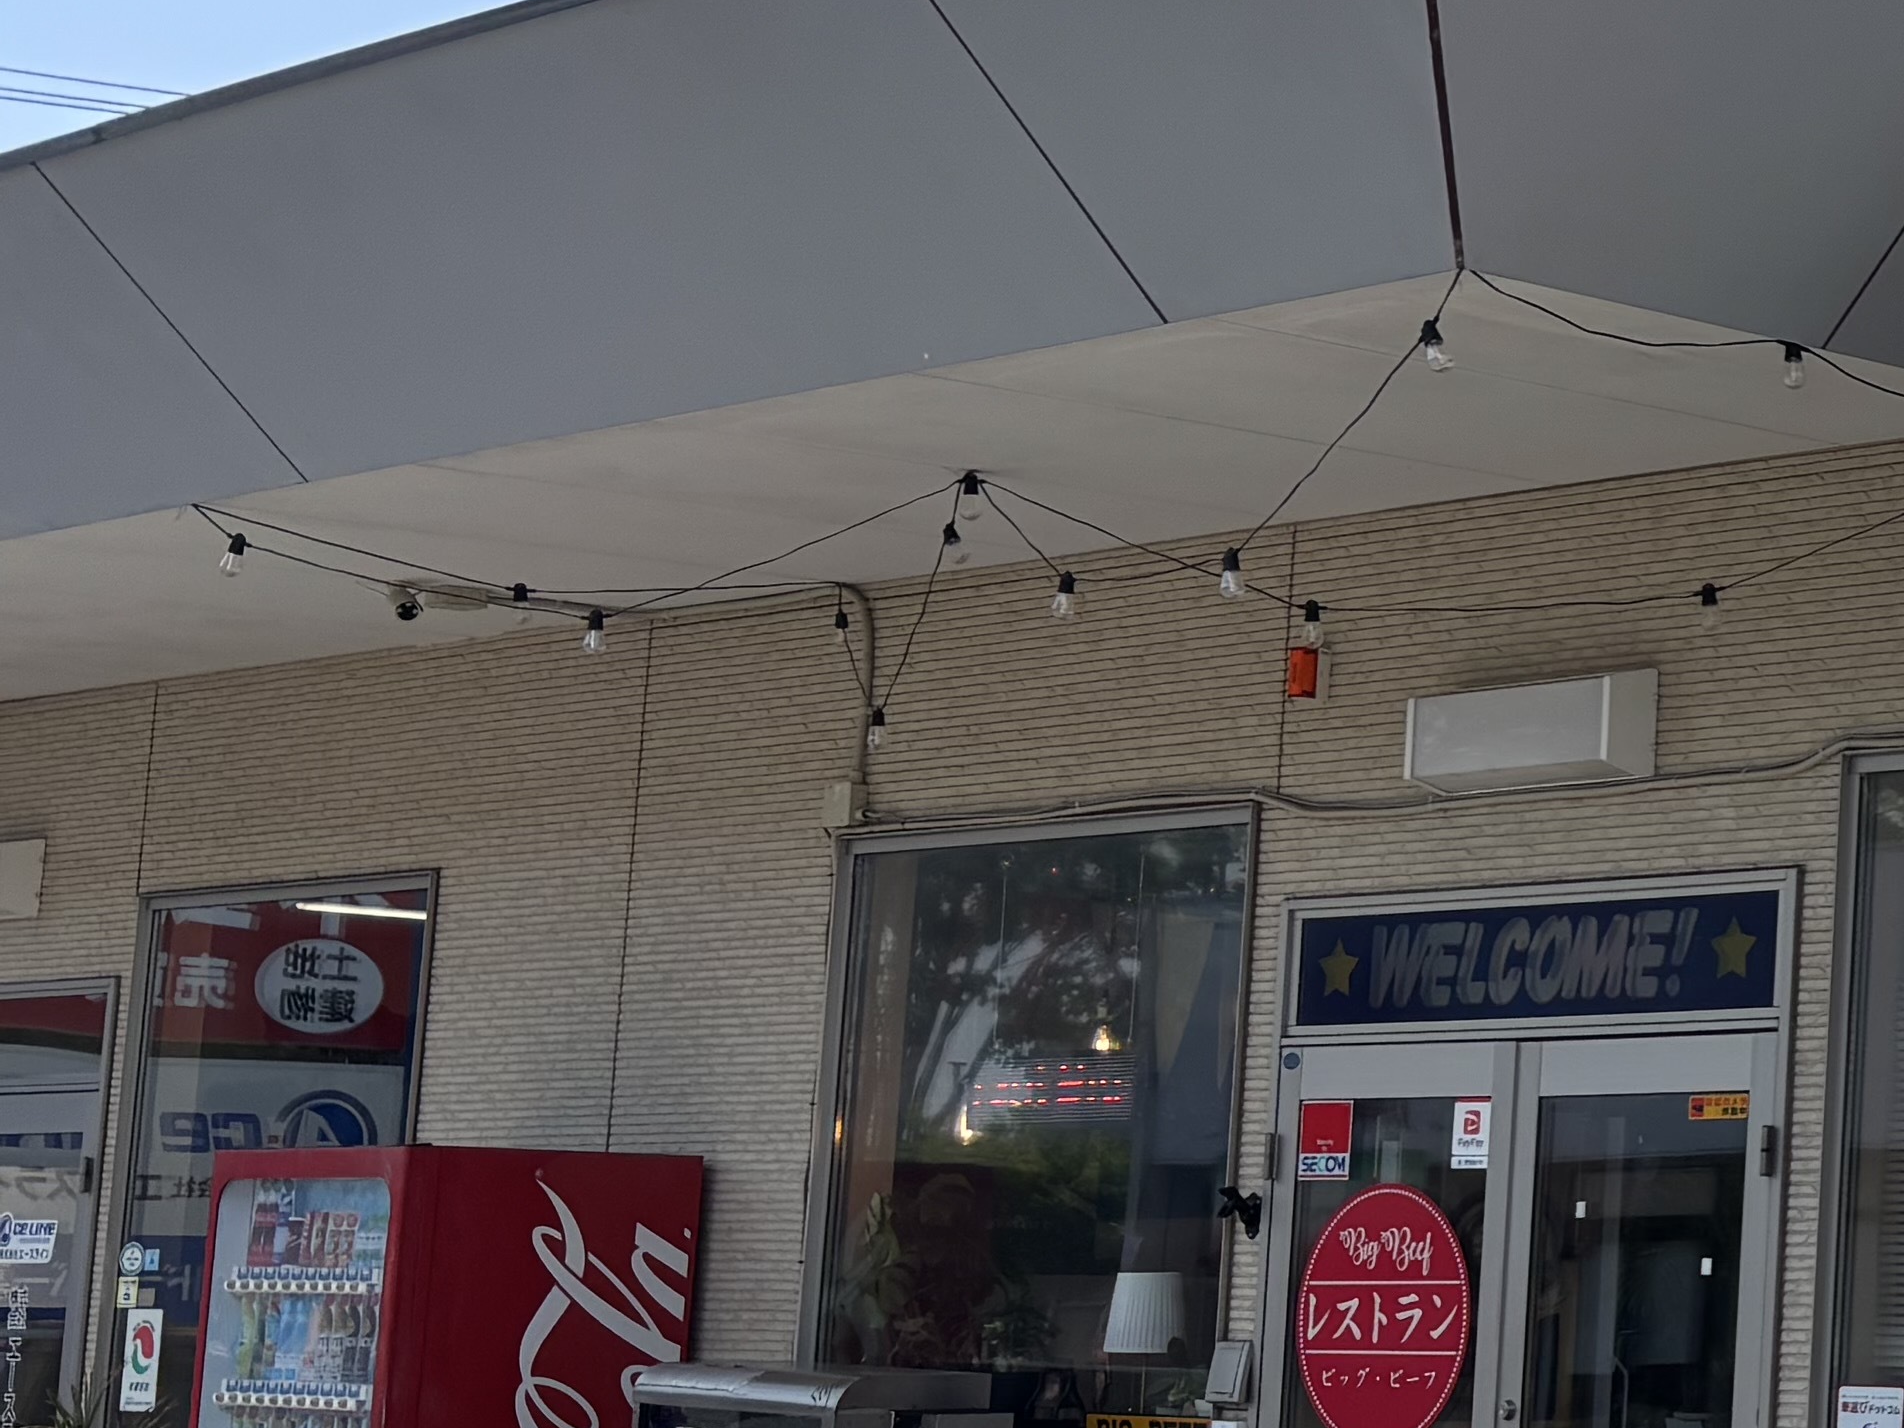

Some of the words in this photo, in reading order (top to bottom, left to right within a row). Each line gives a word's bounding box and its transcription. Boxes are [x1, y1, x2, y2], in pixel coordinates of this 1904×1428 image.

[1368, 907, 1699, 1010] WELCOME!
[1301, 1155, 1346, 1173] SECOM
[1339, 1226, 1381, 1270] Big
[1379, 1225, 1434, 1277] Beef
[1306, 1291, 1459, 1344] レストラン
